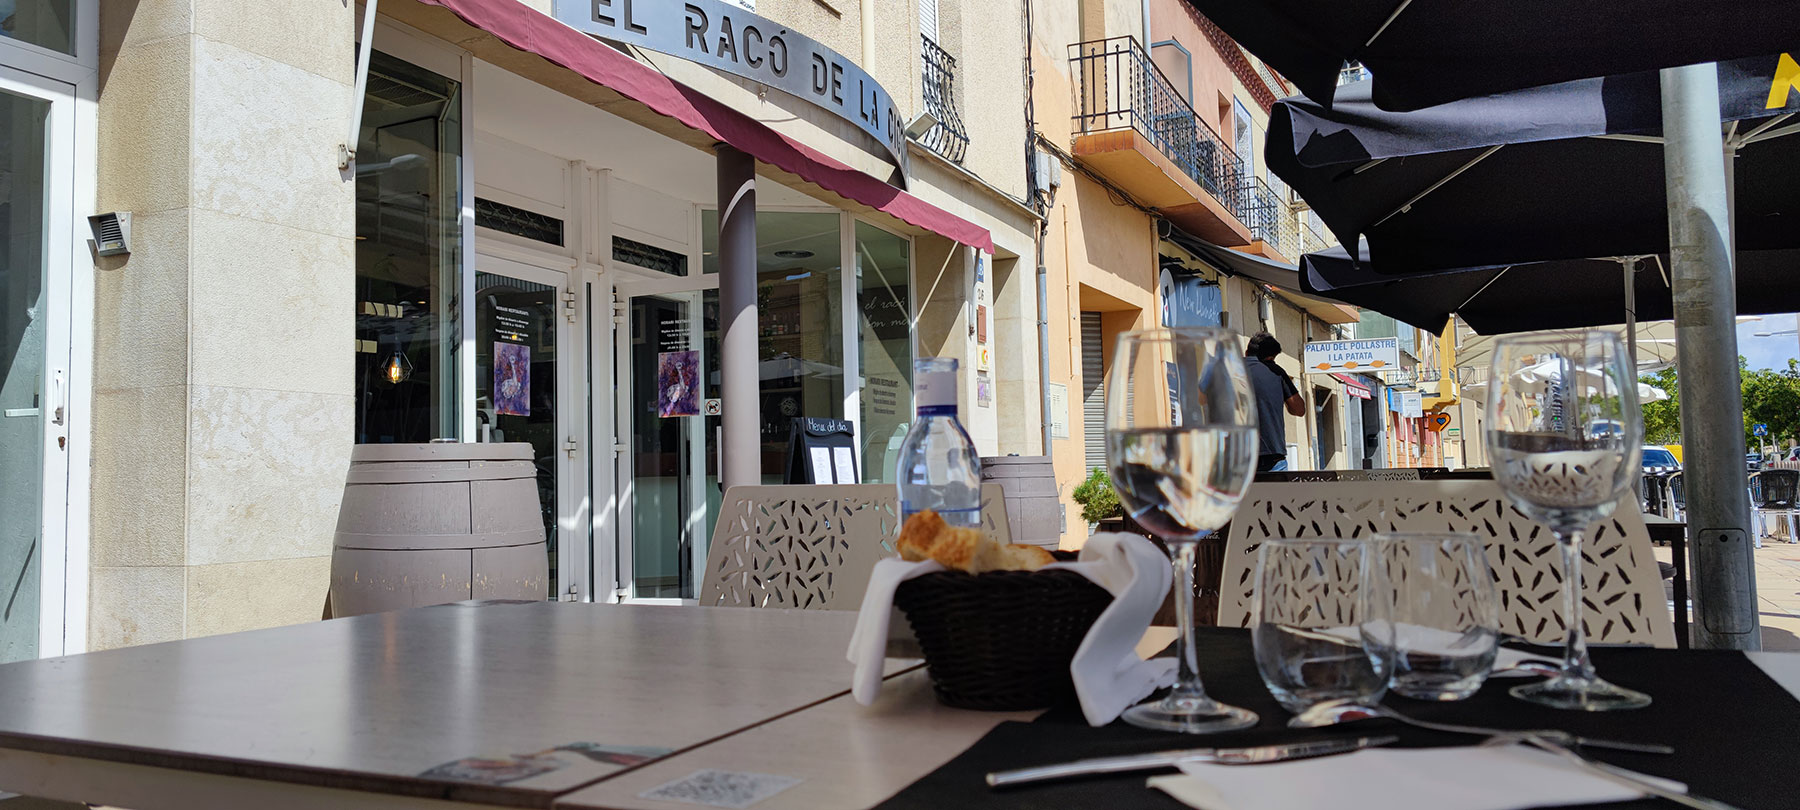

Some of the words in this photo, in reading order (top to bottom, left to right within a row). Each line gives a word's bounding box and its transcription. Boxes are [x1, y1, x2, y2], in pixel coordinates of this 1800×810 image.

[591, 0, 647, 36] EL
[684, 3, 788, 78] RACÓ
[812, 52, 844, 106] DE
[859, 79, 879, 130] LA
[1305, 343, 1331, 352] PALAU
[1333, 342, 1348, 351] DEL
[1350, 340, 1396, 350] POLLASTRE
[1333, 353, 1343, 361] LA
[1345, 351, 1373, 360] PATATA
